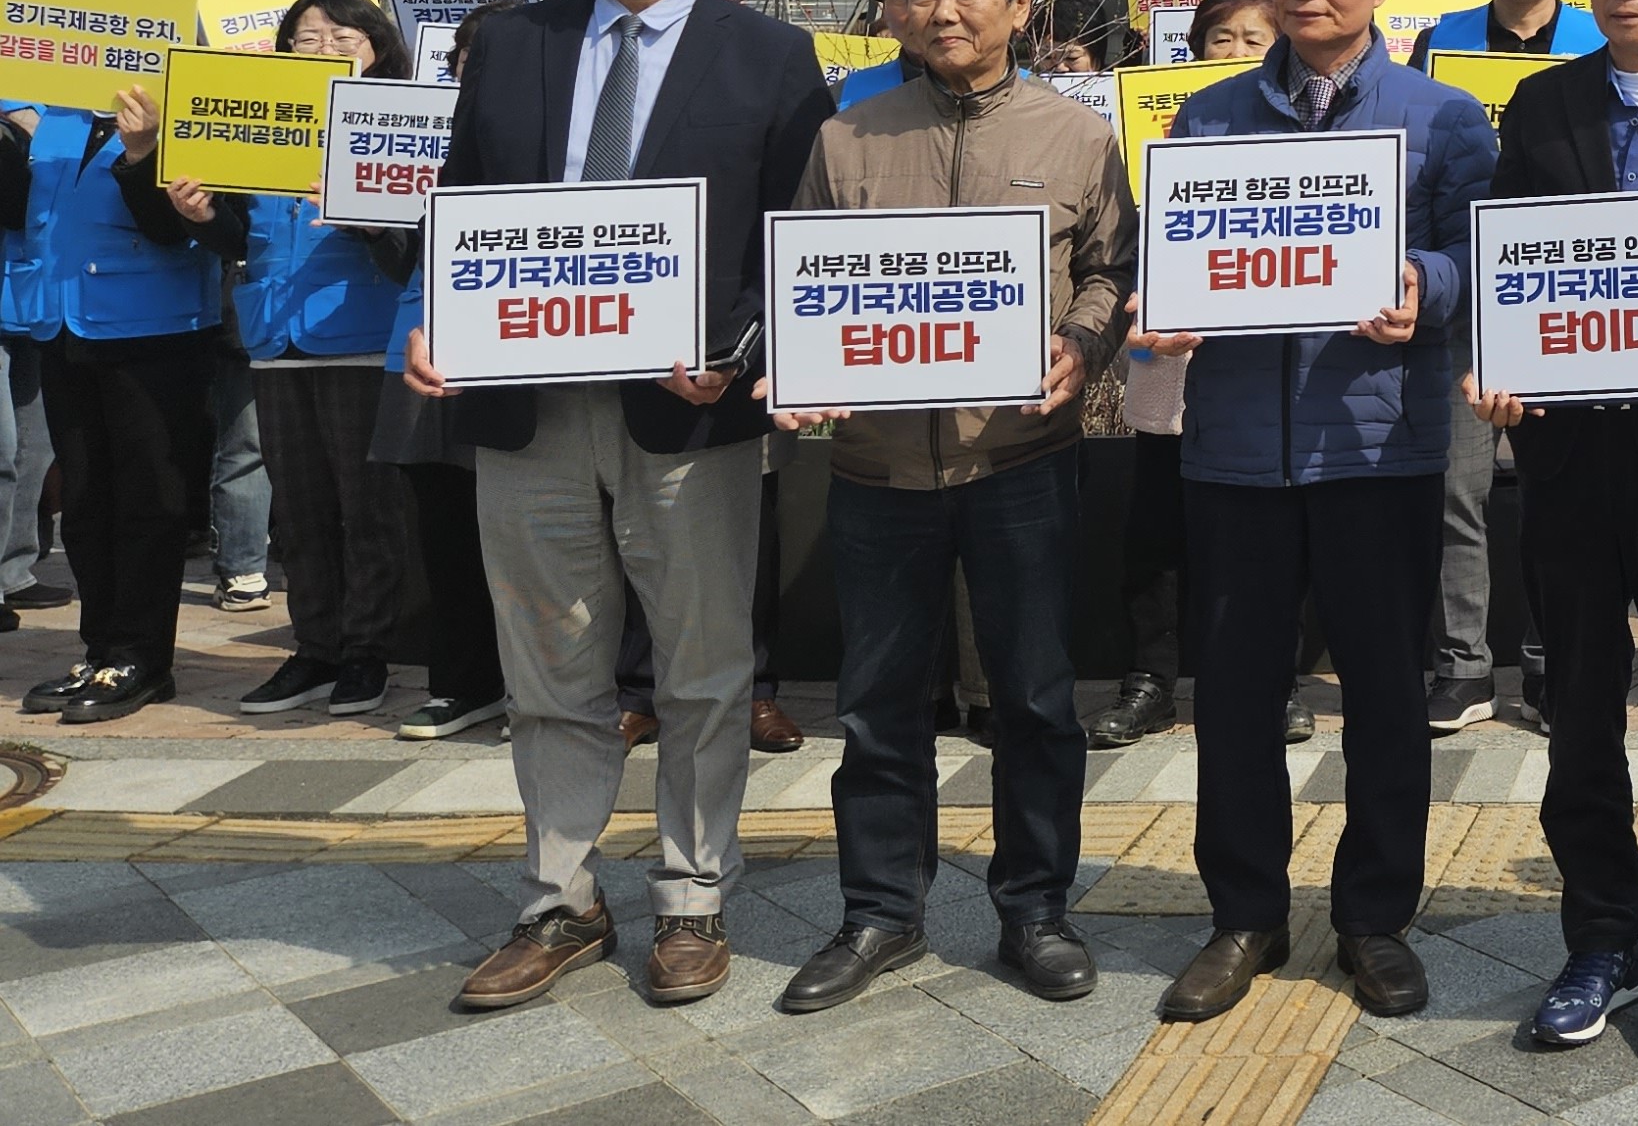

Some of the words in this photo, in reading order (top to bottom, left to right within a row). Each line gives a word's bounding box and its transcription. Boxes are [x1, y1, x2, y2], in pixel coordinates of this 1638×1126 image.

[6, 2, 129, 36] 경기국제공항
[135, 18, 181, 44] 유치,
[0, 34, 55, 62] 갈등을
[62, 42, 98, 67] 넘어
[105, 47, 164, 74] 화합으
[191, 96, 269, 121] 일자리와
[275, 101, 319, 125] 물류,
[342, 111, 374, 126] 제7차
[377, 112, 429, 128] 공항개발
[174, 119, 310, 148] 경기국제공항이
[355, 161, 444, 197] 반영하
[1168, 178, 1238, 204] 서부권
[1246, 176, 1290, 201] 항공
[1299, 173, 1373, 199] 인프라,
[455, 227, 528, 252] 서부권
[536, 225, 584, 250] 항공
[593, 222, 672, 248] 인프라,
[1165, 203, 1380, 242] 경기국제공항이
[796, 253, 871, 278] 서부권
[879, 252, 928, 276] 항공
[936, 250, 1016, 275] 인프라,
[1208, 244, 1338, 291] 답이다
[1498, 240, 1565, 267] 서부권
[1572, 236, 1617, 263] 항공
[451, 251, 679, 291] 경기국제공항이
[498, 292, 635, 340] 답이다
[792, 279, 1024, 317] 경기국제공항이
[841, 321, 981, 367] 답이다
